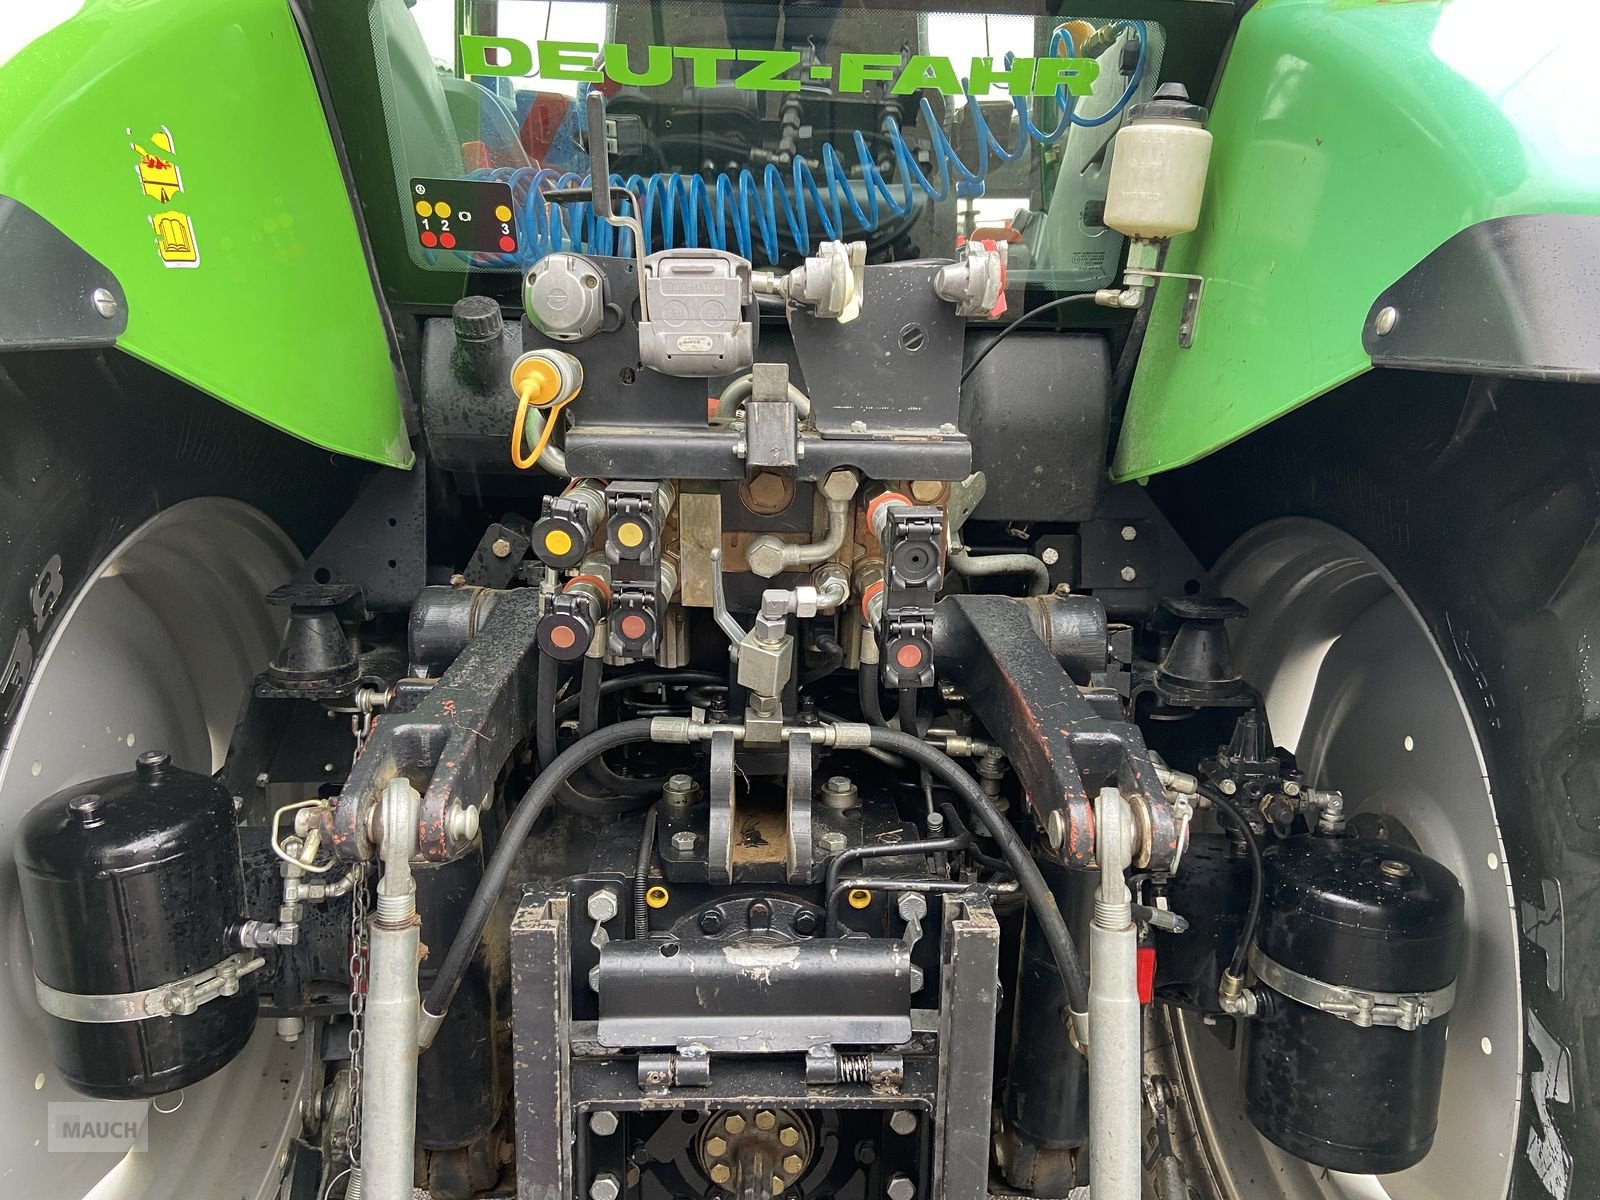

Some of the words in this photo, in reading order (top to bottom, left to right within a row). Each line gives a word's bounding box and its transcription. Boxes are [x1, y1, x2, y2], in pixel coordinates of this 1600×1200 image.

[459, 34, 1100, 97] DEUTZ-FAHR
[422, 218, 430, 230] 1
[441, 220, 450, 231] 2
[501, 223, 510, 235] 3
